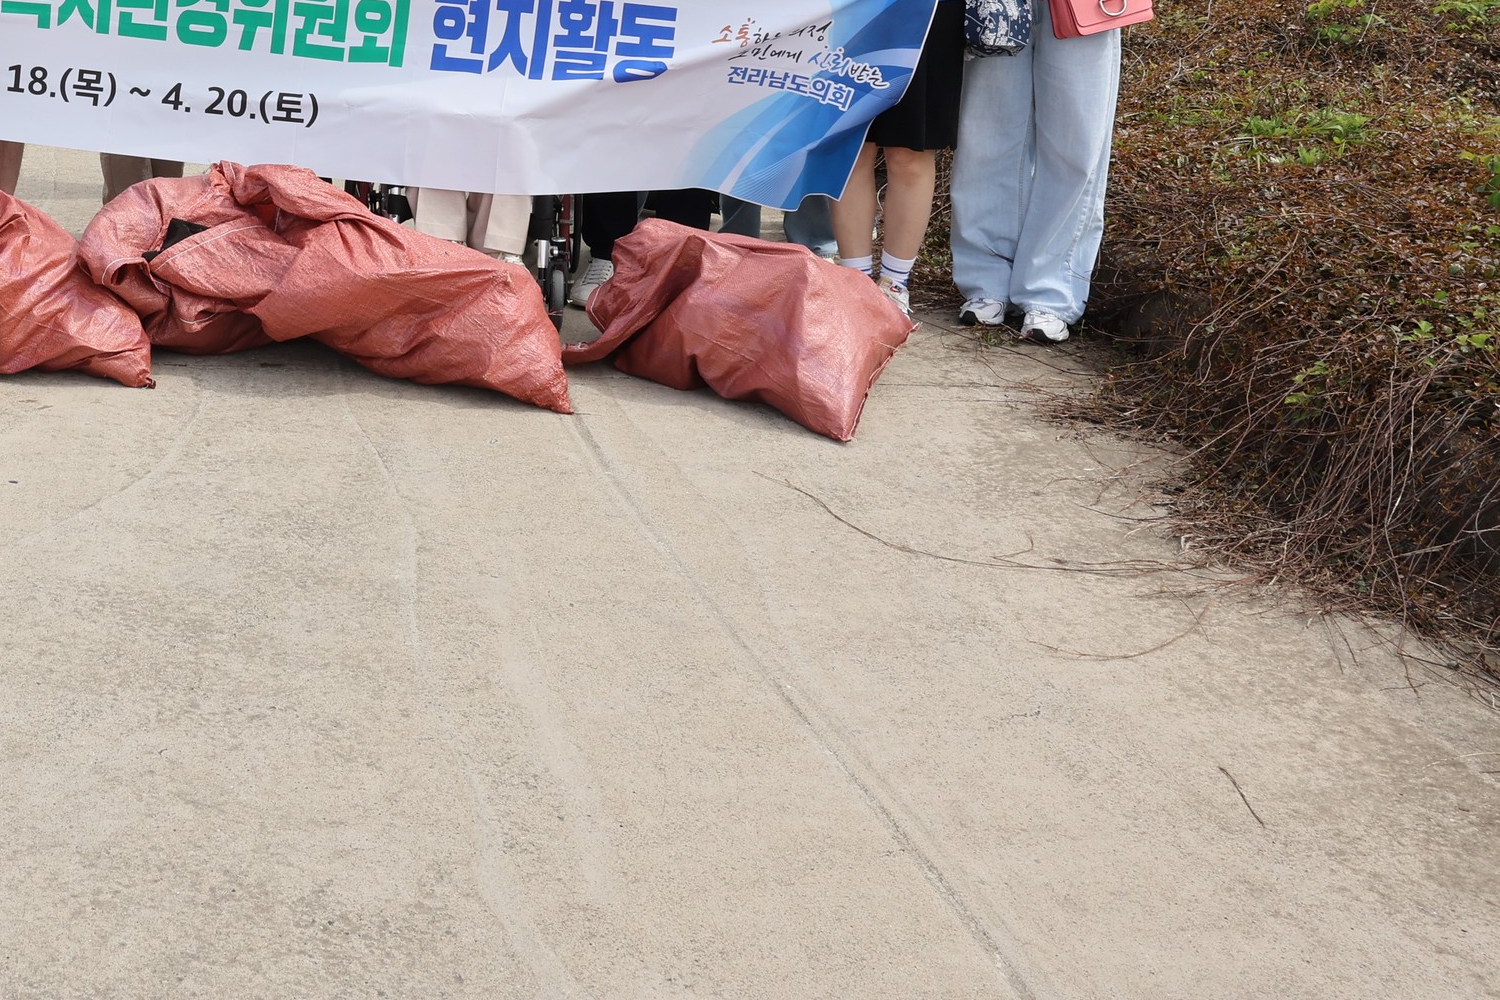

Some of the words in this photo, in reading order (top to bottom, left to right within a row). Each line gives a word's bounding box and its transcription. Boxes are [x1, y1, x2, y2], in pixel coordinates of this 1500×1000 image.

[7, 64, 117, 107] 18.(목)
[129, 85, 151, 98] ~
[161, 82, 191, 113] 4.
[204, 86, 319, 128] 20.(토)
[727, 66, 854, 110] 전라남도의회
